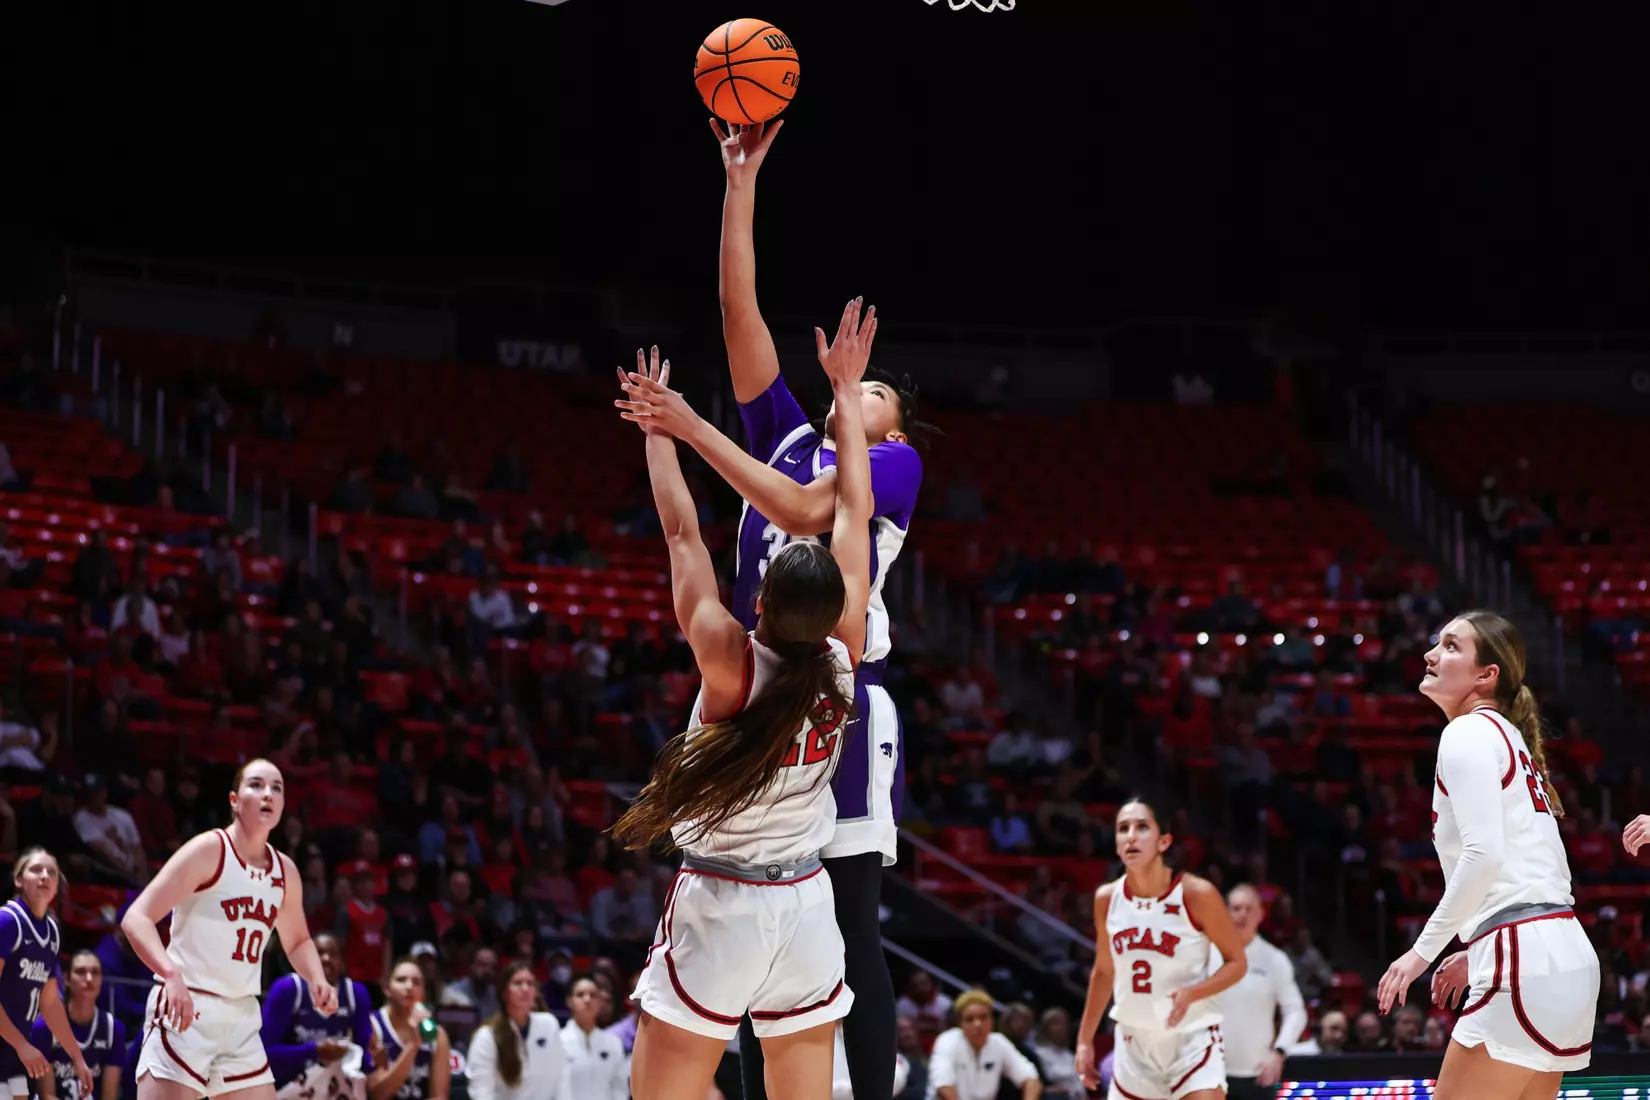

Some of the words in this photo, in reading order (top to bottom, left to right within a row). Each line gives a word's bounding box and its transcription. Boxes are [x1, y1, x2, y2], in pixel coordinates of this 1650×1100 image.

[231, 927, 263, 965] 10
[1112, 927, 1182, 959] UTAH
[1131, 960, 1152, 994] 2
